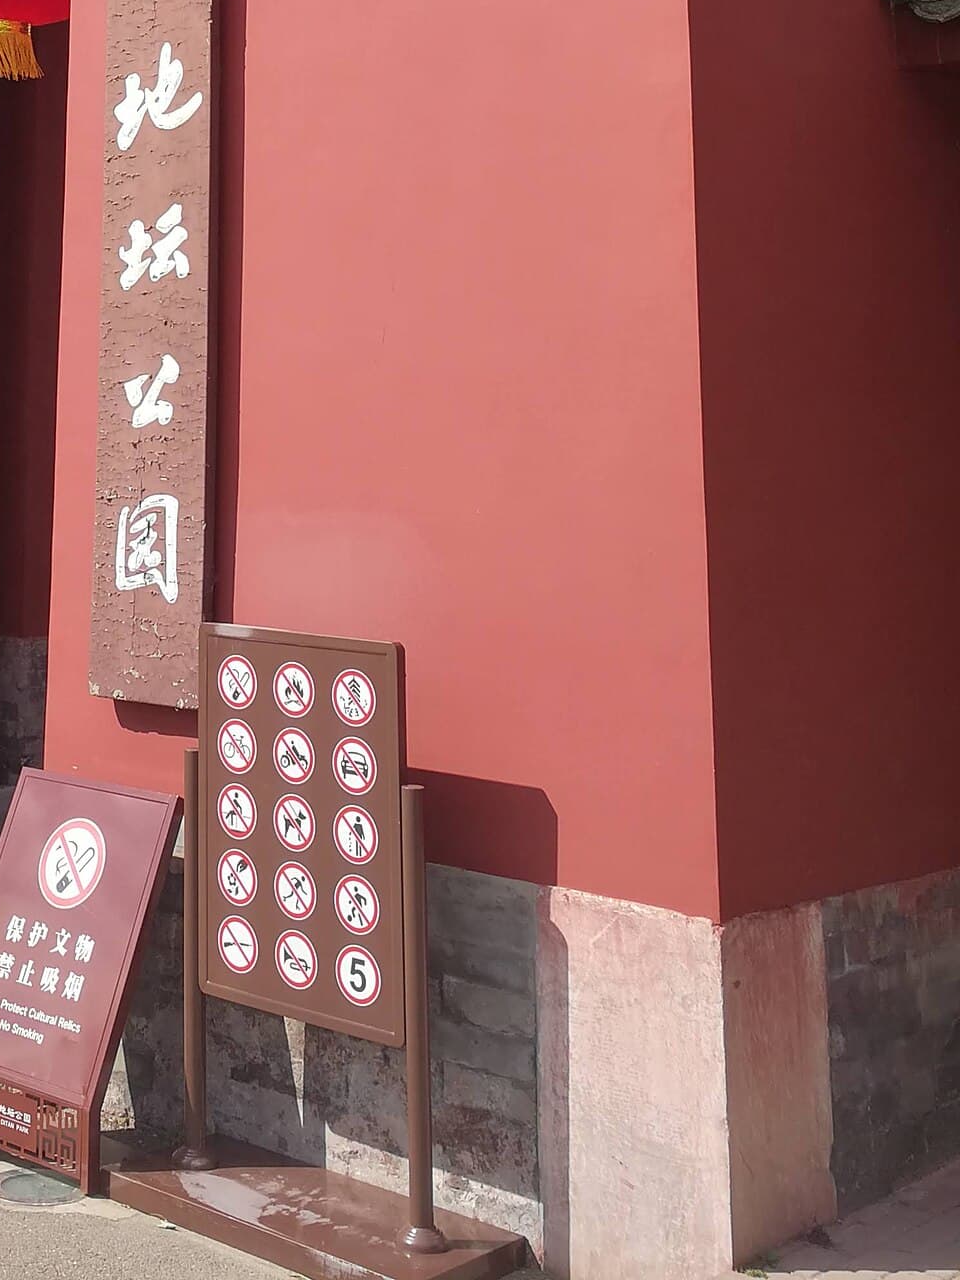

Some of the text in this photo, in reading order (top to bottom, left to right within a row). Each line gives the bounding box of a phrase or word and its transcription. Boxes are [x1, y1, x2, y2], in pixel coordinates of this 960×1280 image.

[5, 915, 96, 963] 保护文物
[349, 956, 367, 993] 5
[0, 999, 28, 1017] Protect
[28, 1007, 58, 1026] Cultural
[58, 1016, 81, 1034] Relics
[0, 1019, 44, 1045] No Smoking
[0, 1118, 30, 1135] DITAN PARK
